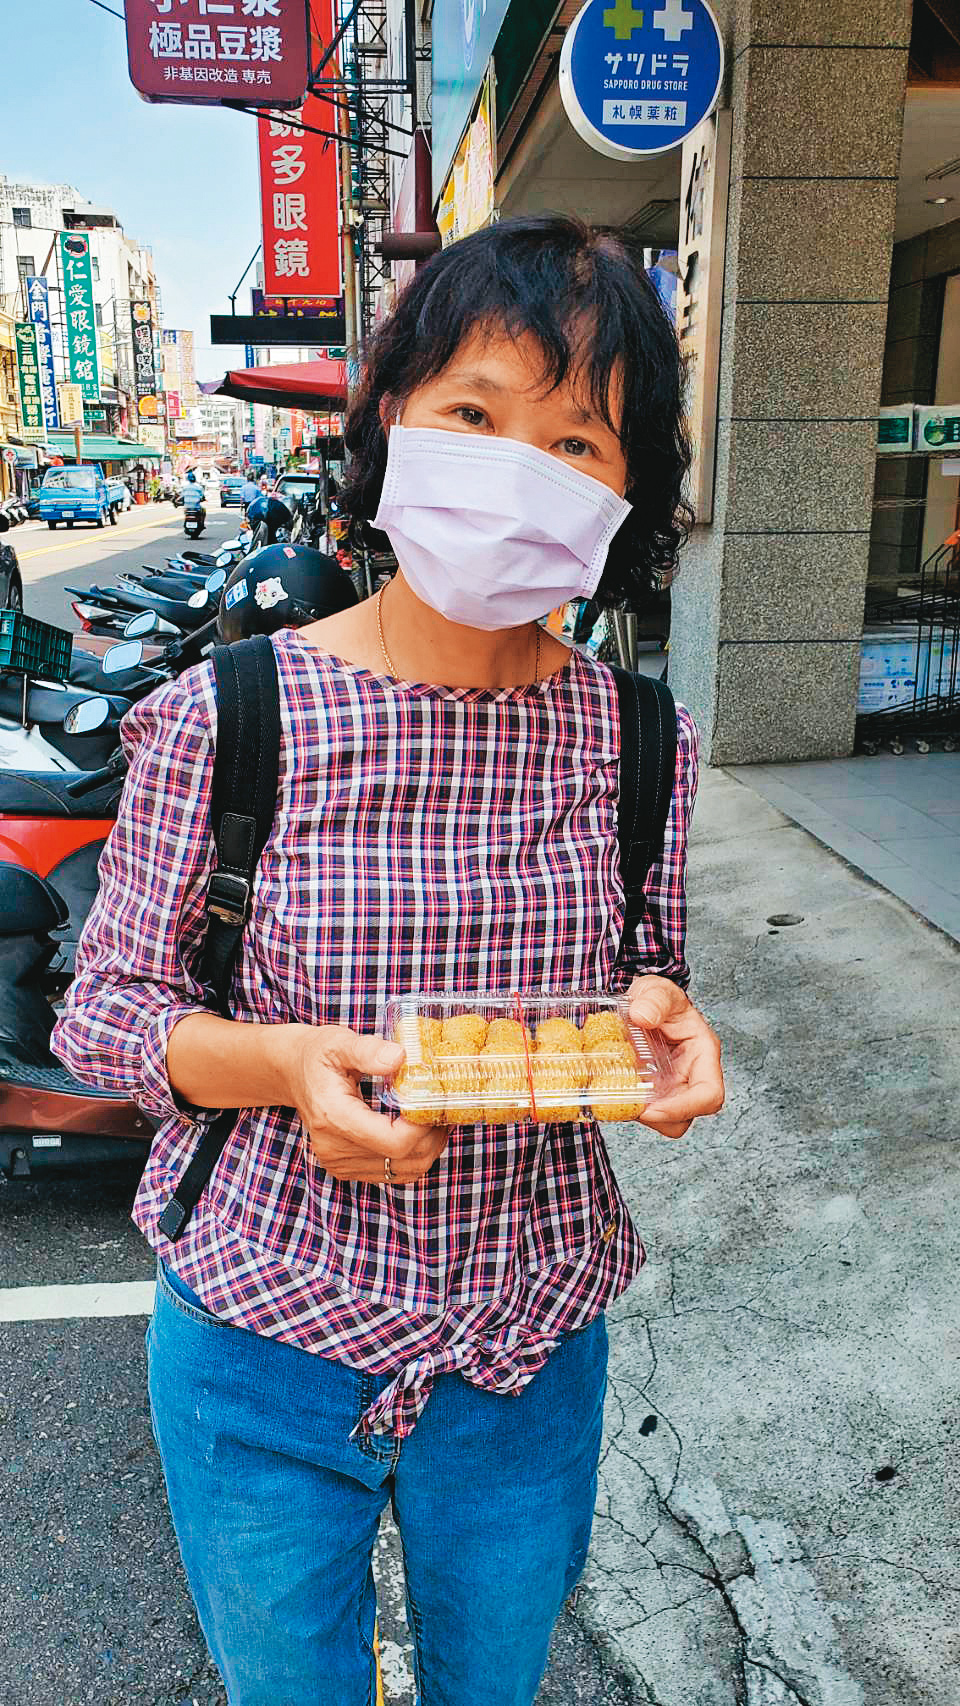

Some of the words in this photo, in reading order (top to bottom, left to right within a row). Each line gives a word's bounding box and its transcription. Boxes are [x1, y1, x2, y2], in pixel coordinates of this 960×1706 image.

[148, 21, 283, 62] 極品豆漿
[163, 66, 239, 84] 非基因改造
[604, 52, 689, 77] サツドラ
[603, 79, 639, 90] SAPPORO
[641, 80, 662, 90] DRUG
[663, 81, 689, 91] STORE
